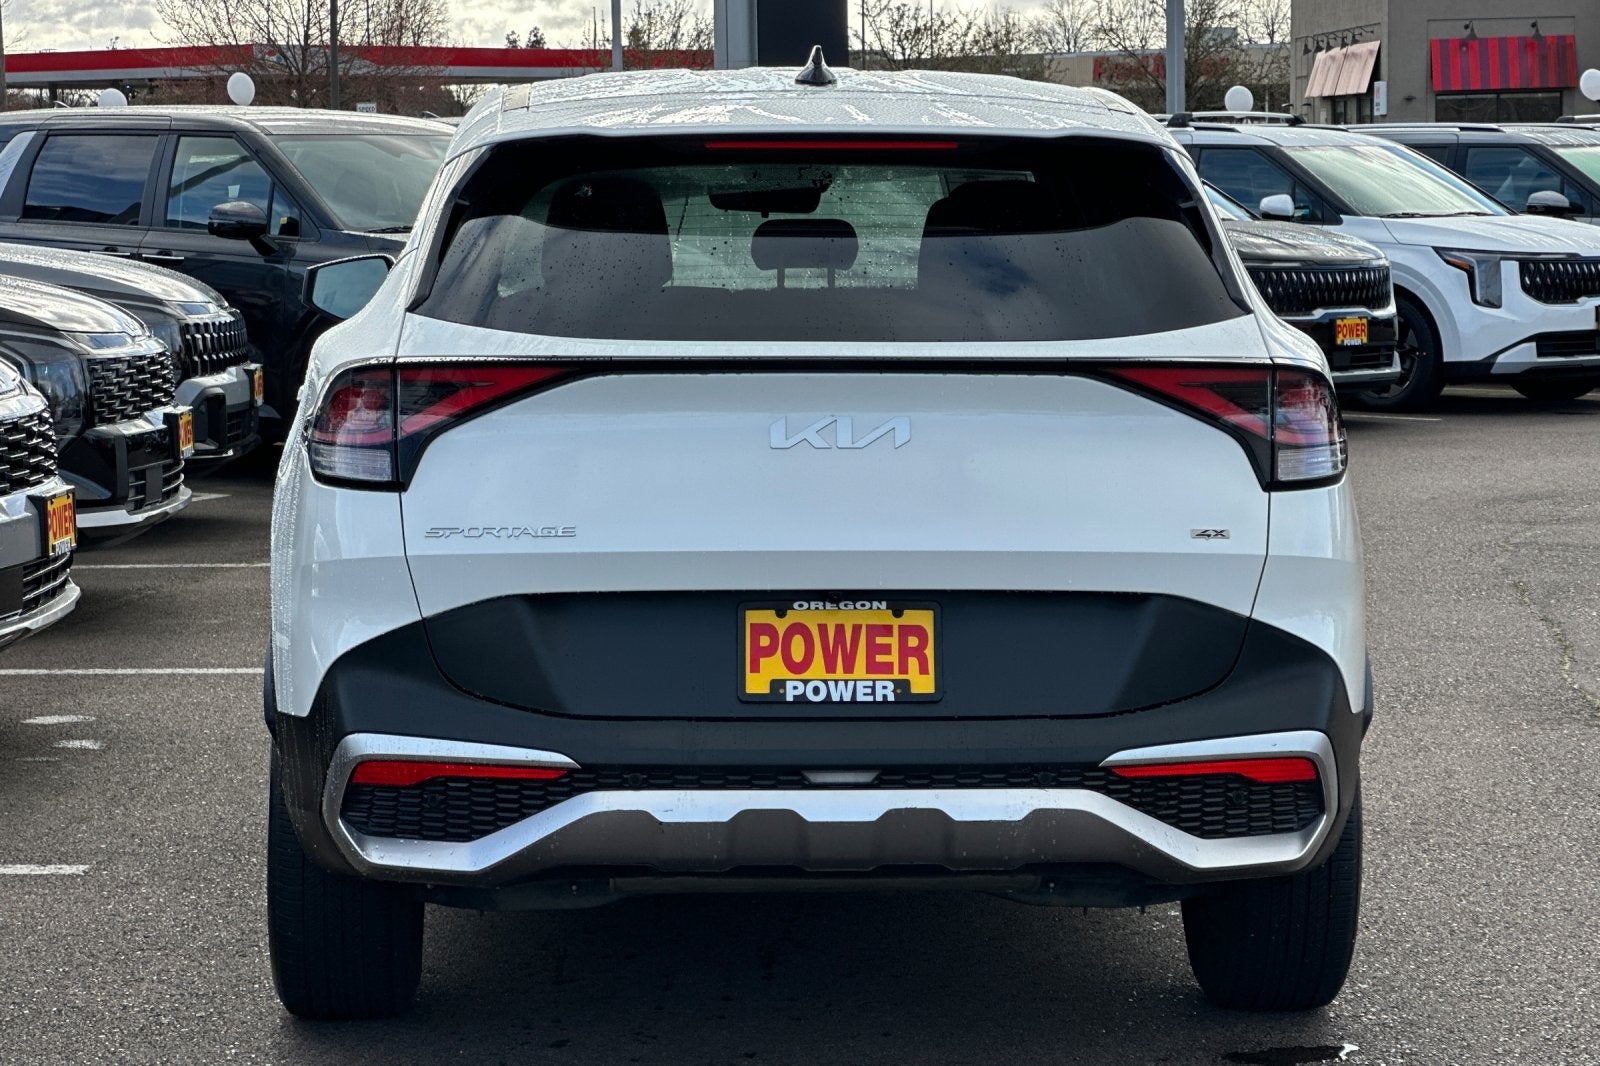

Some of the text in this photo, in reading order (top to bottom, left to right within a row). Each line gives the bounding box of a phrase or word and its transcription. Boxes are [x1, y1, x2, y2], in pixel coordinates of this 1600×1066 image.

[1336, 322, 1367, 338] POWER
[769, 415, 911, 450] KIA
[424, 526, 577, 539] SPORTAGE
[792, 600, 888, 611] OREGON
[749, 621, 930, 676] POWER
[785, 680, 896, 702] POWER
